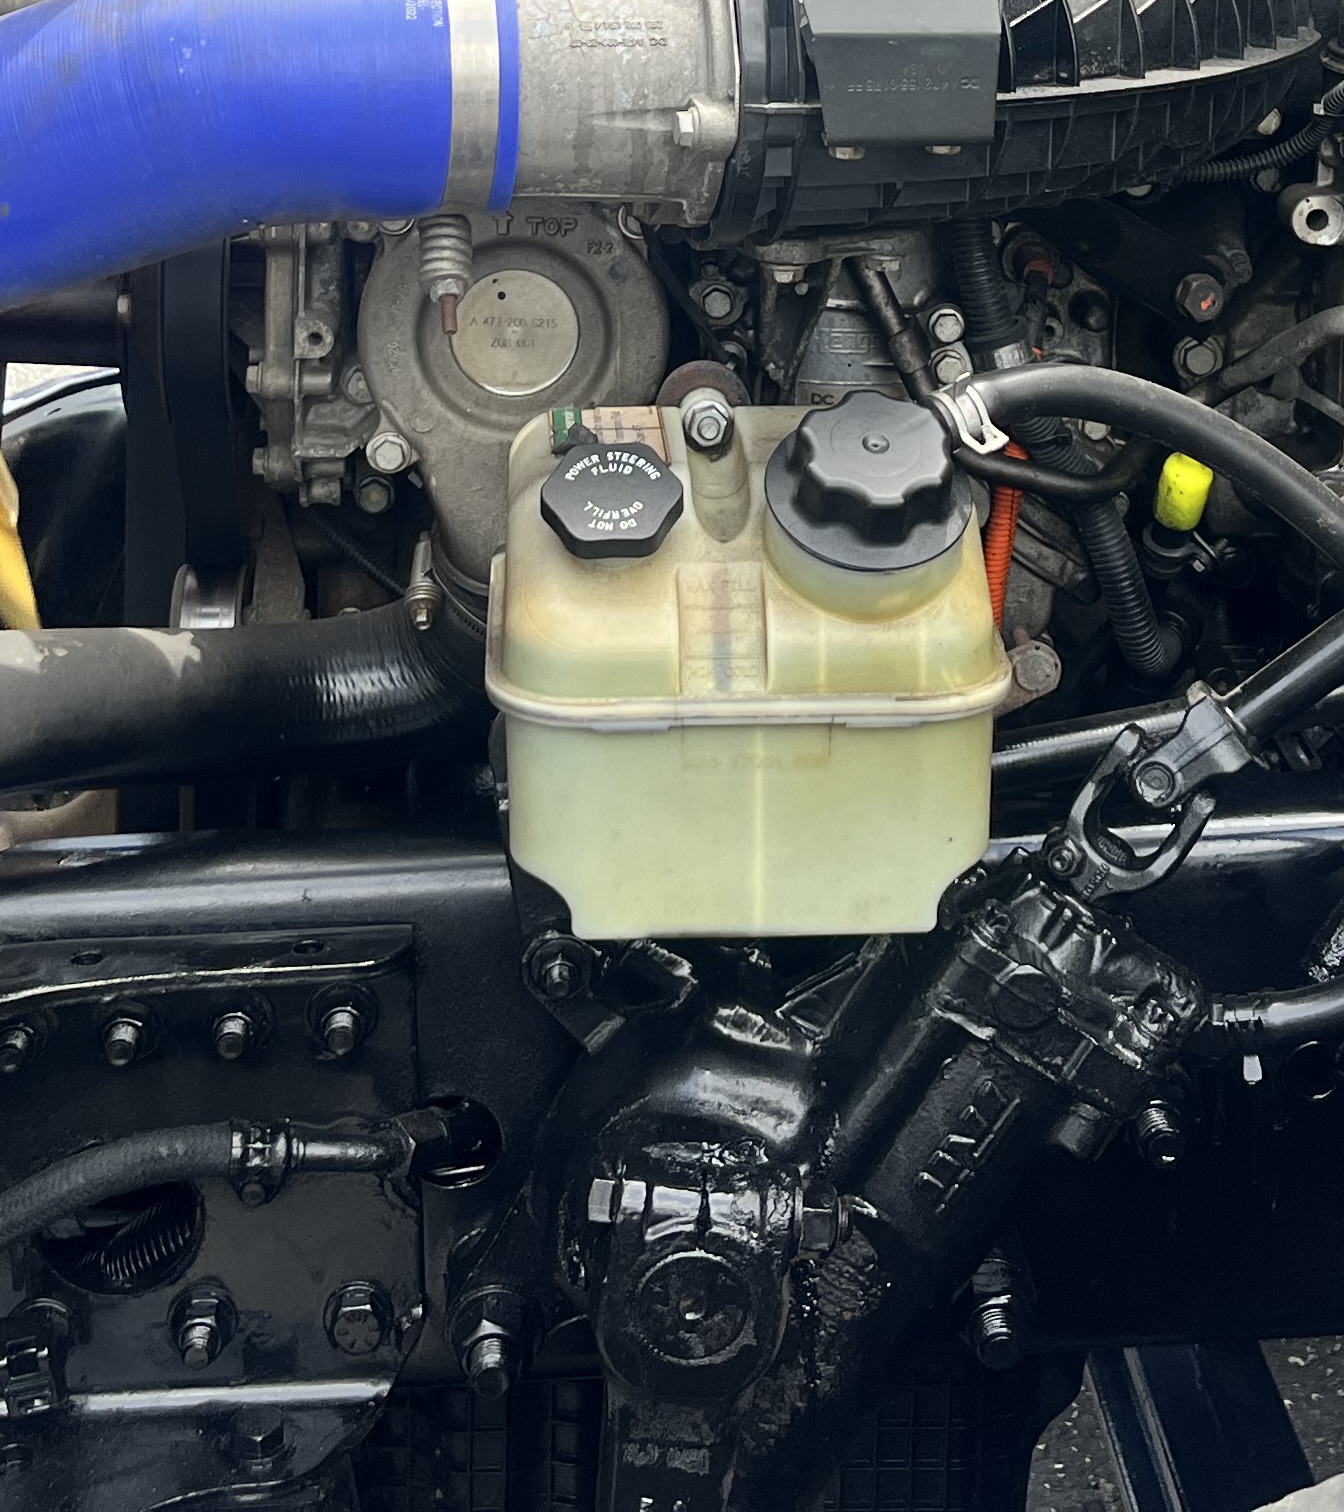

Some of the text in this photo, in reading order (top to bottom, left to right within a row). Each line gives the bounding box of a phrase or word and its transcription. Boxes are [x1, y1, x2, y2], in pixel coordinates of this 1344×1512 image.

[525, 216, 578, 237] TOP
[811, 393, 835, 405] DC
[563, 451, 662, 481] POWER STEERING
[590, 462, 634, 476] FLUID
[583, 500, 645, 520] OVERFILL
[587, 518, 638, 531] DO NOT
